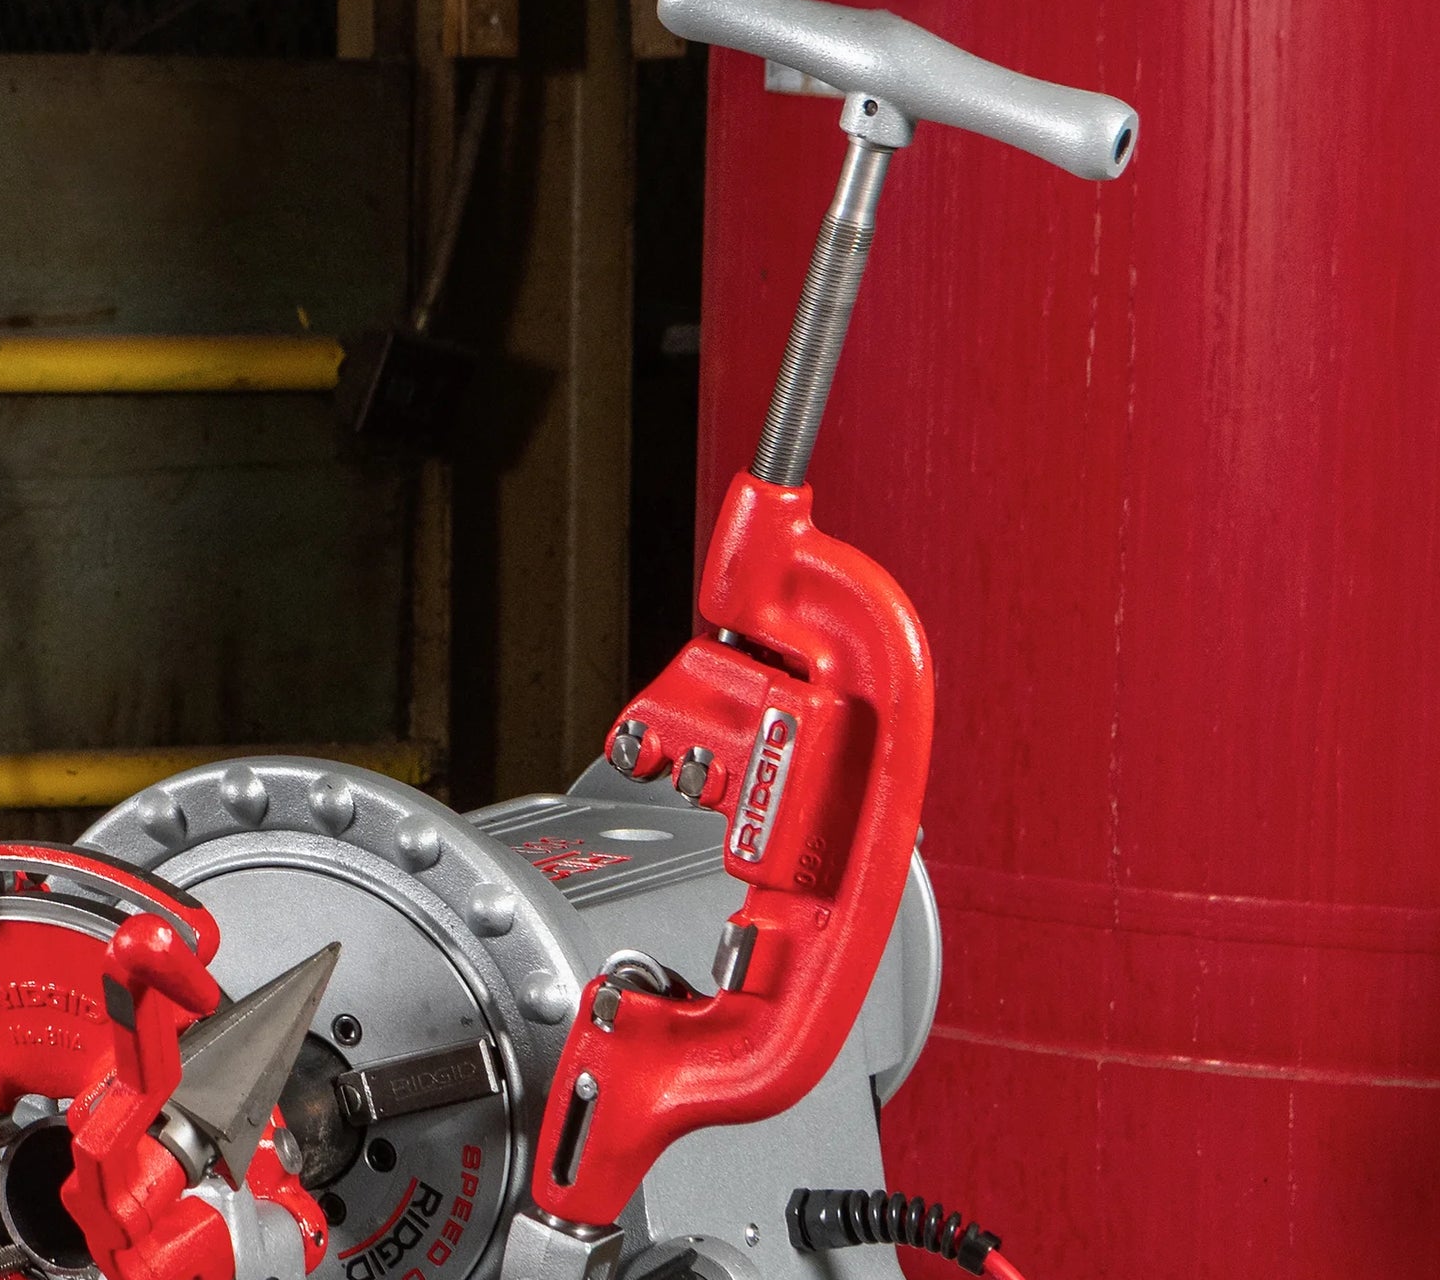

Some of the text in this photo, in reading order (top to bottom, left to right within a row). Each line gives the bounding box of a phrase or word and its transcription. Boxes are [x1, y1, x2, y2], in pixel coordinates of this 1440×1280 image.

[737, 718, 789, 855] RIDGID
[390, 1062, 478, 1101] RIDGID
[426, 1144, 482, 1267] SPEED
